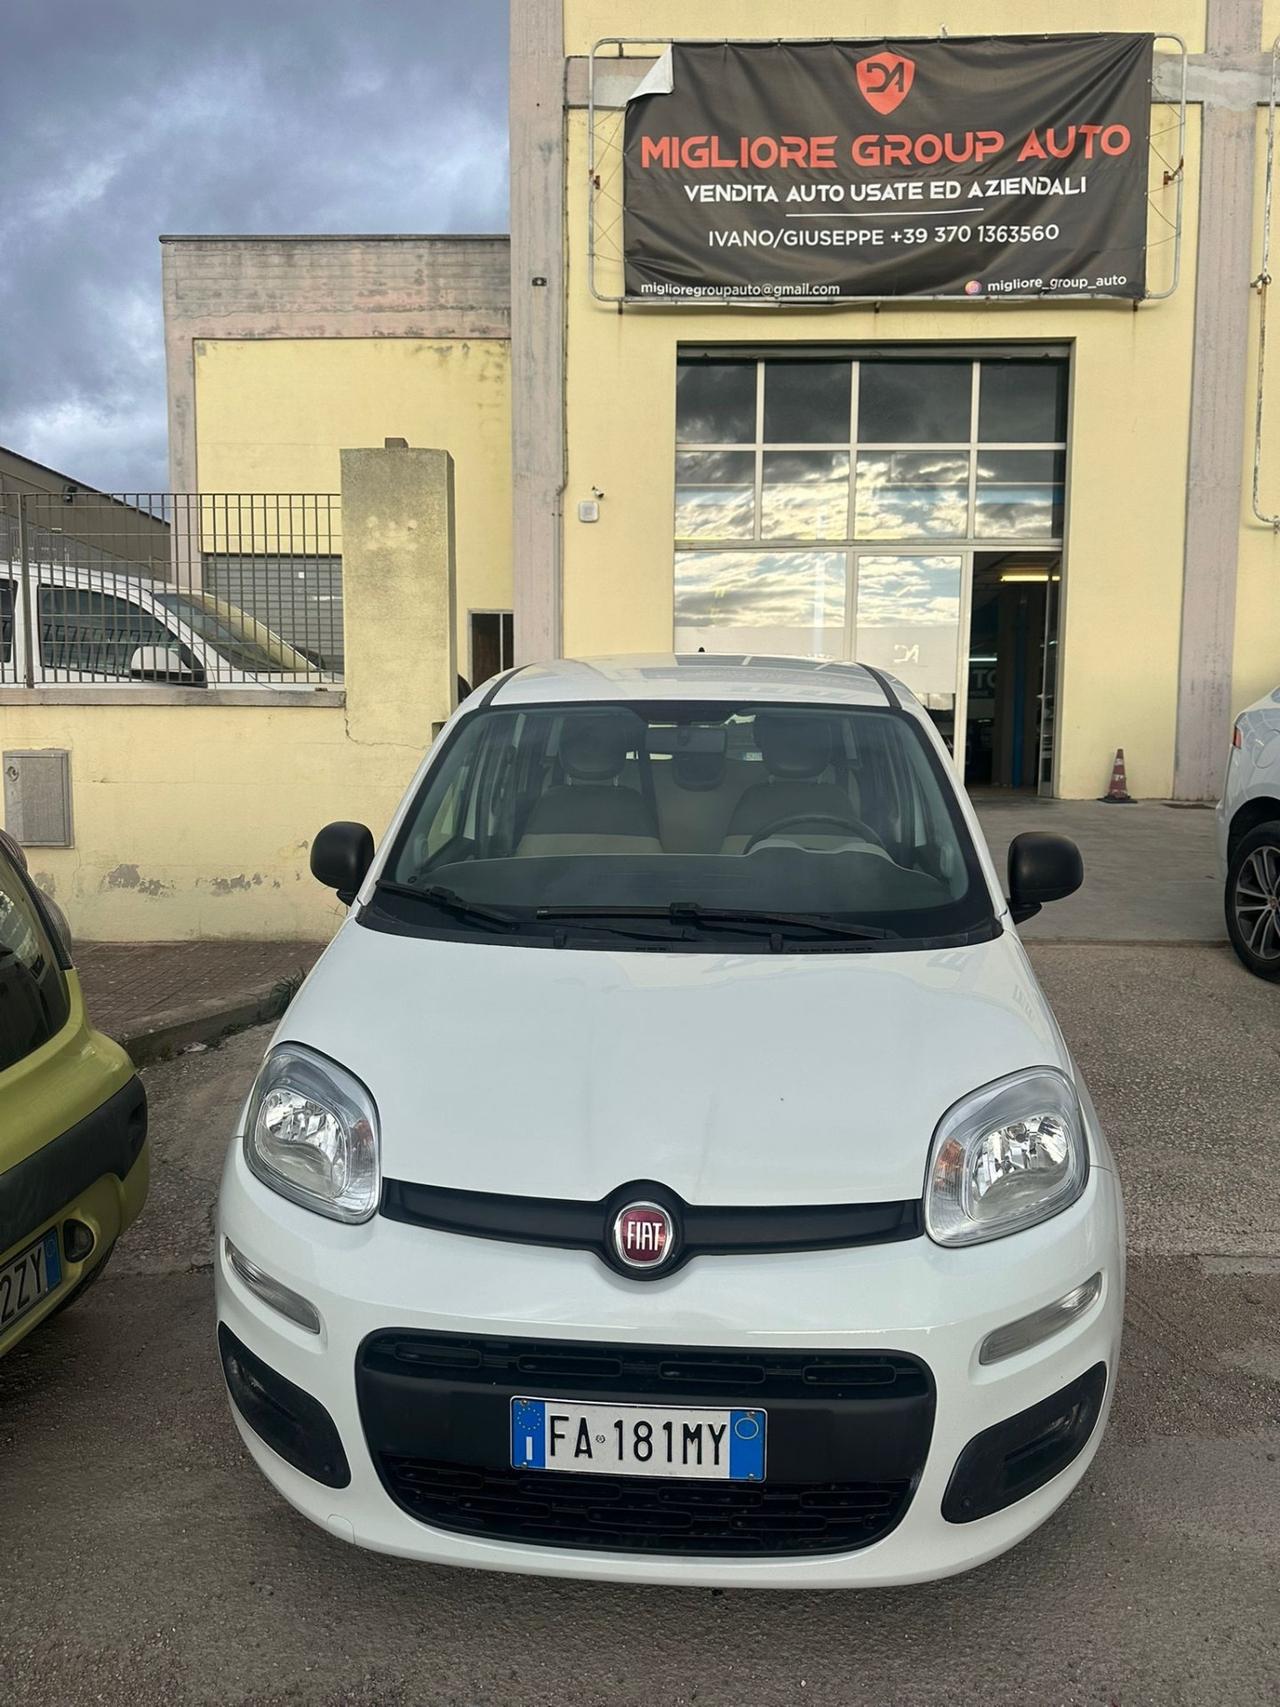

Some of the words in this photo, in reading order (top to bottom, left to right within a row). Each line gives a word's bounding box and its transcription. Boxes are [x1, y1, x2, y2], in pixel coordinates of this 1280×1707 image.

[641, 135, 839, 169] MIGLIORE
[852, 131, 1006, 167] GROUP
[1016, 124, 1132, 162] AUTO
[684, 184, 779, 203] VENDITA
[786, 184, 845, 203] AUTO
[850, 181, 924, 202] USATE
[929, 180, 962, 200] ED
[967, 175, 1087, 199] AZIENDALI
[708, 228, 885, 248] IVANO/GIUSEPPE
[890, 228, 928, 245] +39
[934, 226, 972, 243] 370
[977, 224, 1060, 243] 1363560
[640, 282, 841, 298] miglioregroupauto@gmail.com
[987, 274, 1128, 294] migliore_group_auto
[626, 1221, 663, 1251] FIAT
[549, 1415, 593, 1459] FA
[613, 1418, 728, 1466] 181MY
